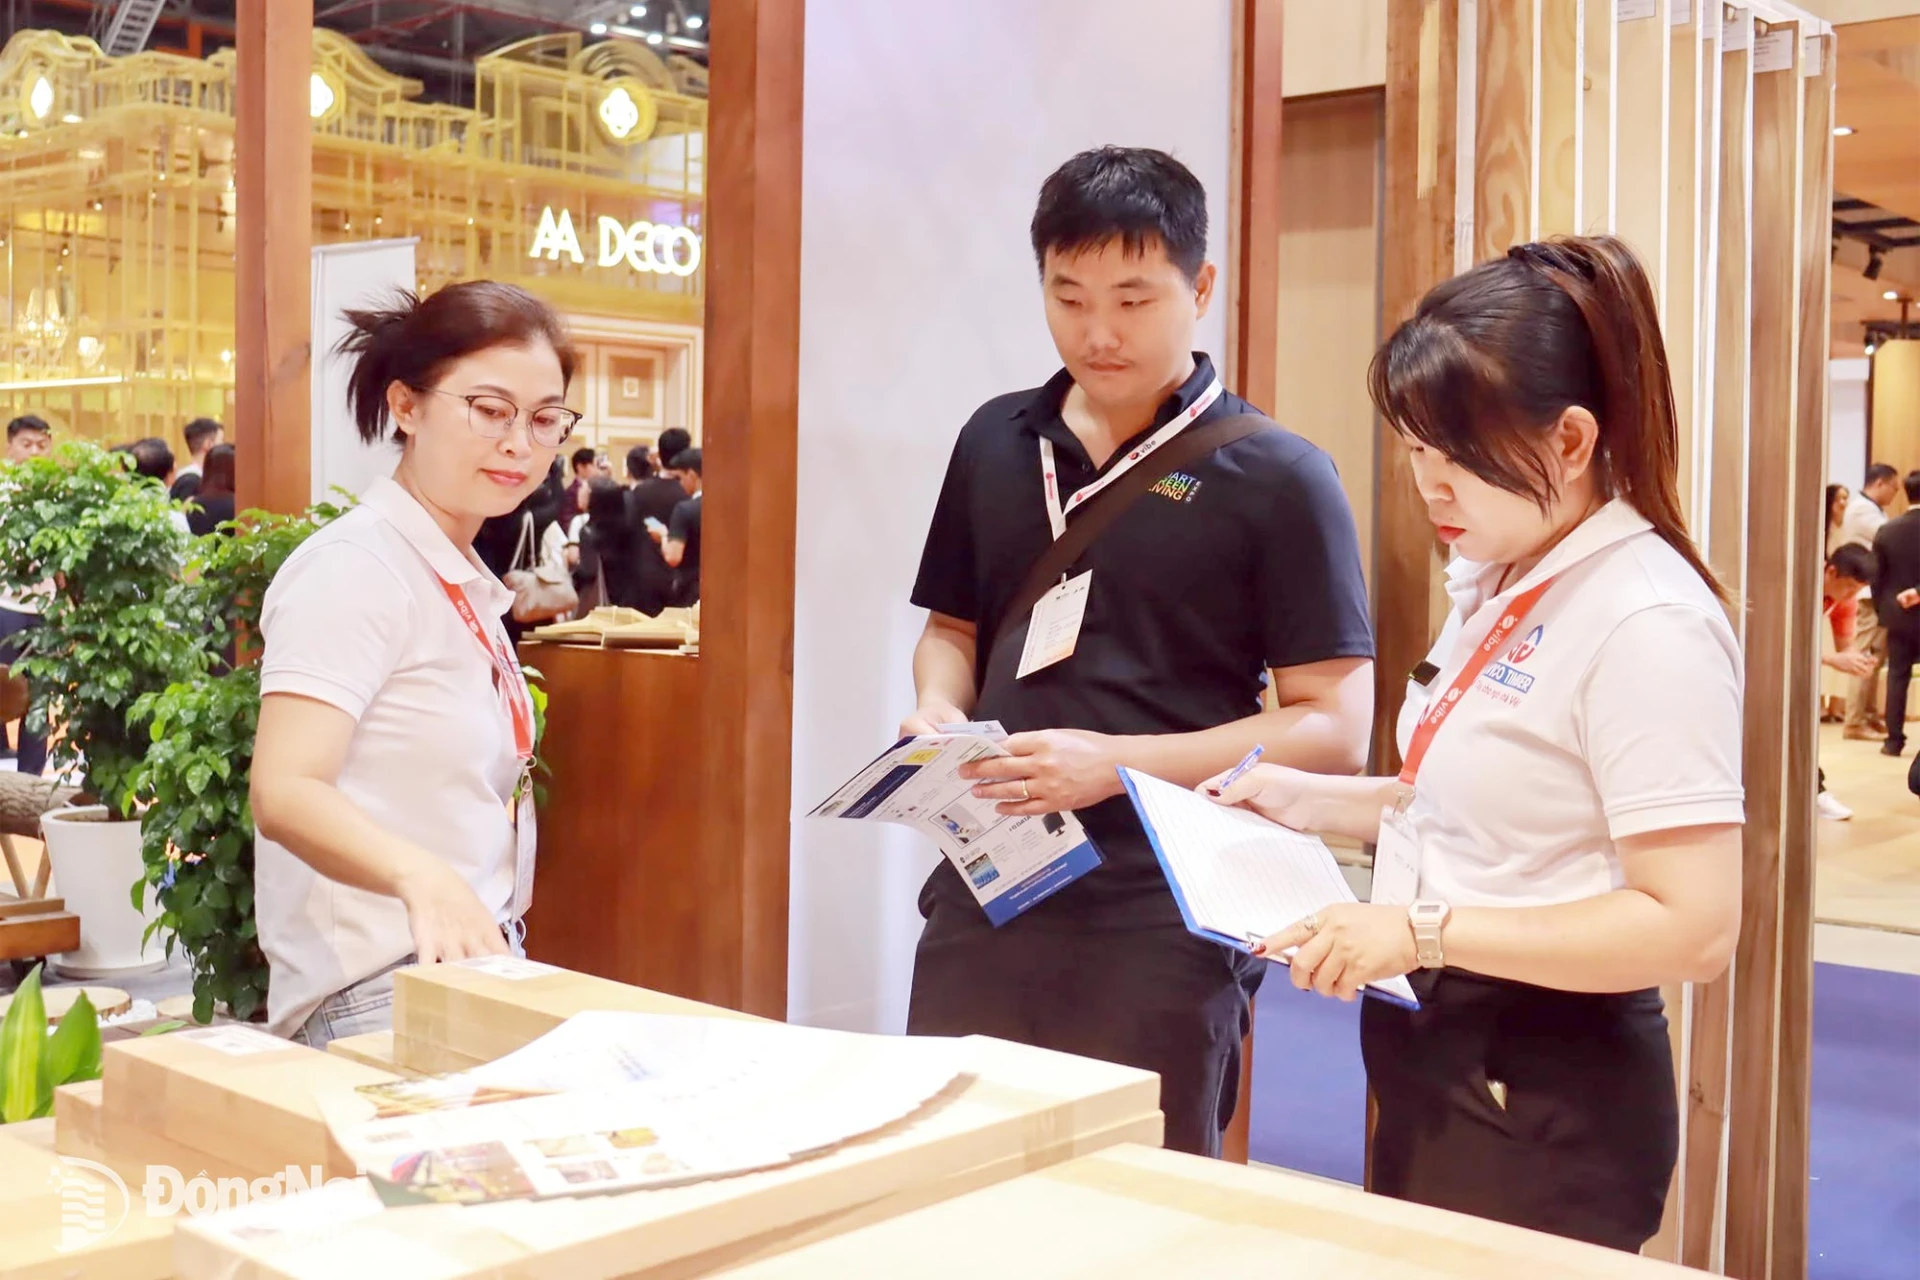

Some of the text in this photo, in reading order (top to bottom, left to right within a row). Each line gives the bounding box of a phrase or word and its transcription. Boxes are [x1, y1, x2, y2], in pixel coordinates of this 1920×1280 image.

[529, 206, 701, 277] AA DECO
[1140, 440, 1156, 453] vibe
[1168, 471, 1197, 487] ART
[1483, 629, 1503, 652] vibe
[1430, 701, 1448, 725] vibe
